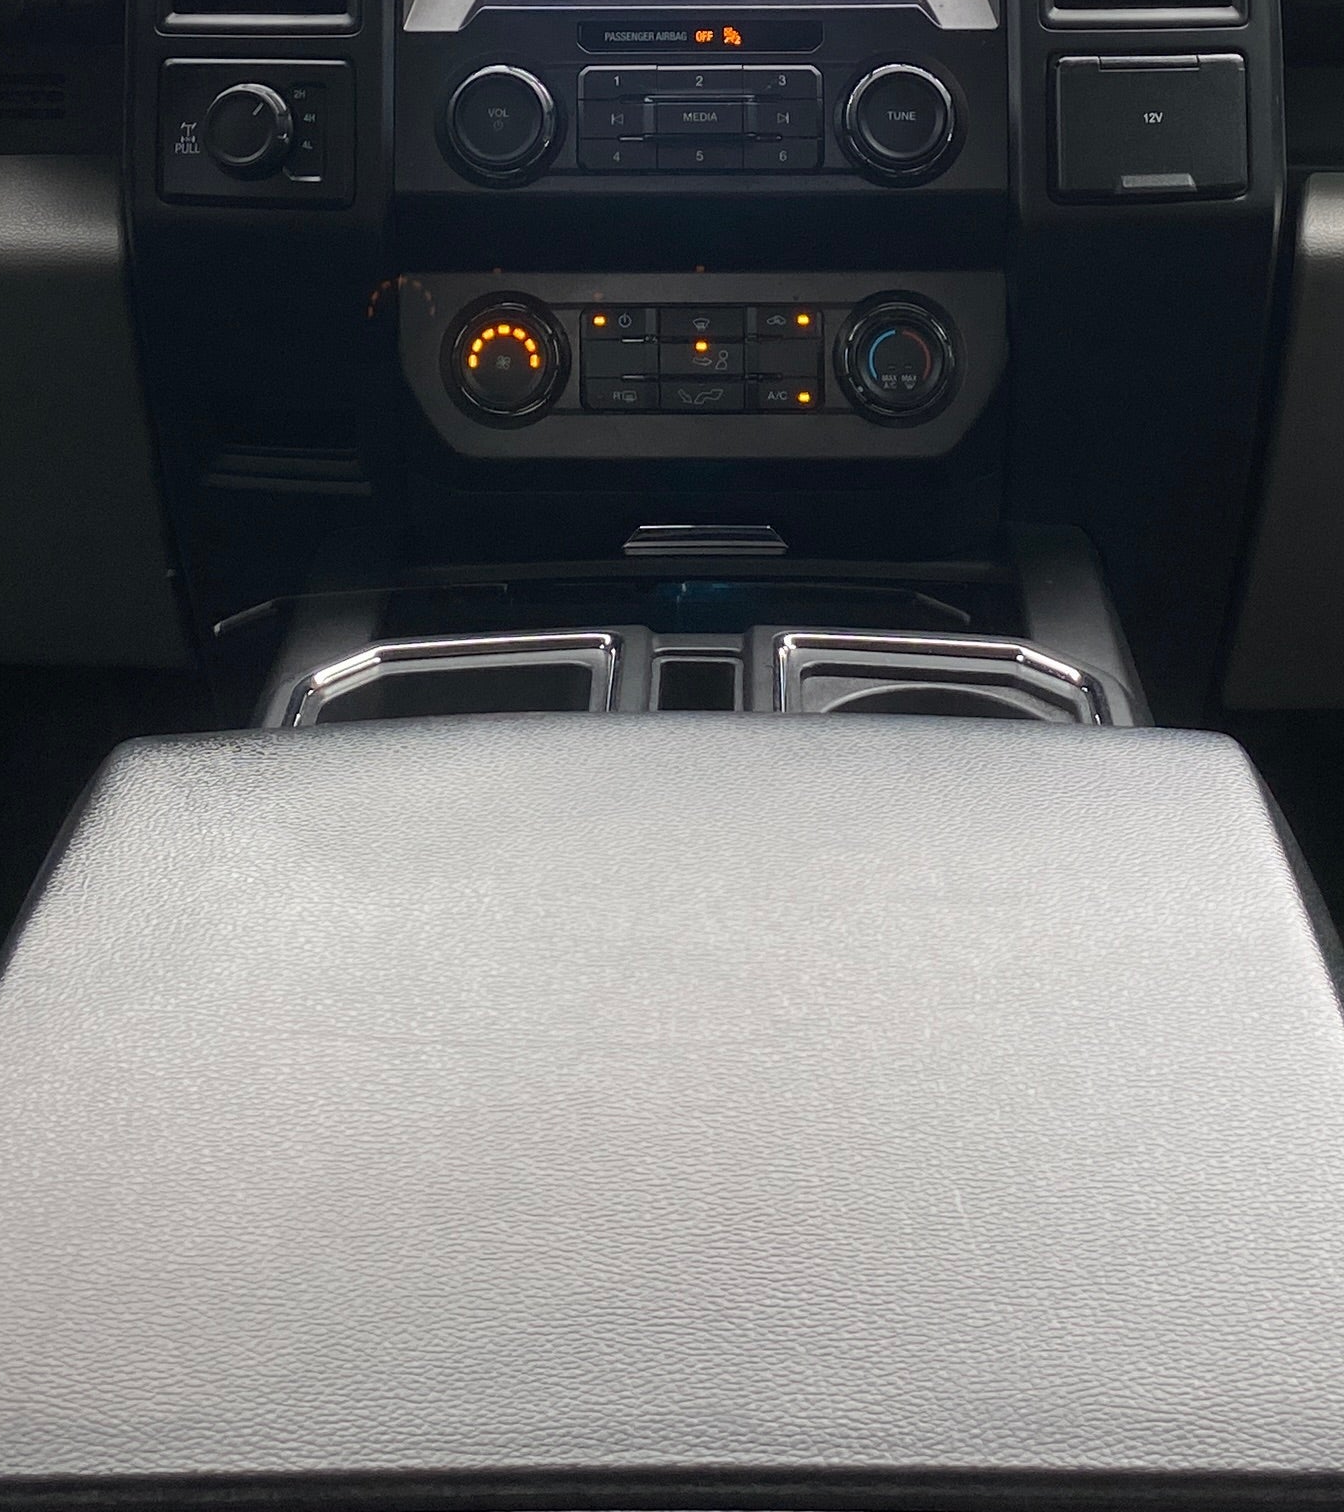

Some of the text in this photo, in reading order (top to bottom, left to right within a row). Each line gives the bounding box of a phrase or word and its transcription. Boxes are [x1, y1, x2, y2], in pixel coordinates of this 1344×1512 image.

[604, 29, 714, 43] PASSENGER AIRBAG OFF
[613, 75, 620, 86] 1
[695, 75, 704, 86] 2
[778, 75, 787, 86] 3
[303, 114, 316, 123] 4H
[487, 108, 509, 119] VOL
[682, 112, 718, 123] MEDIA
[887, 111, 916, 122] TUNE
[1143, 112, 1163, 124] 12V
[174, 143, 200, 154] PULL
[612, 151, 621, 162] 4
[696, 151, 704, 162] 5
[779, 151, 787, 162] 6
[767, 391, 788, 401] A/C
